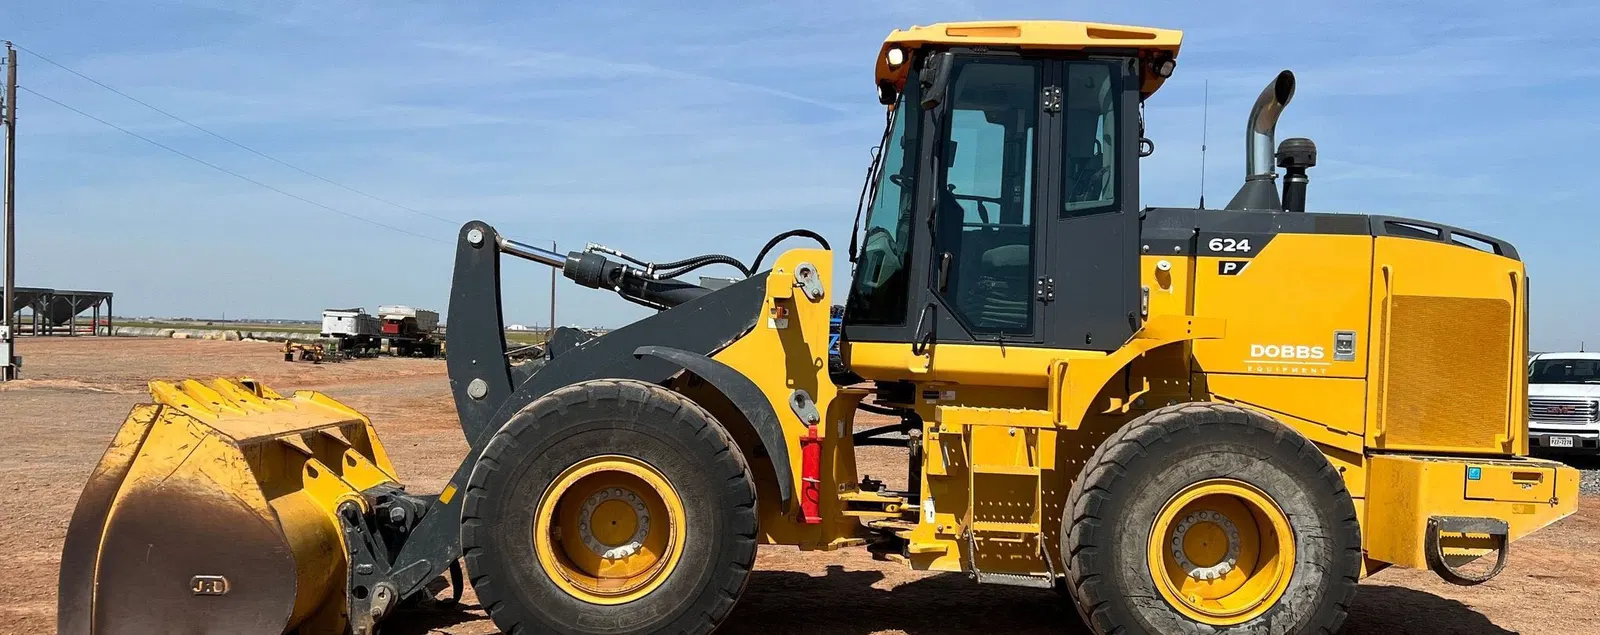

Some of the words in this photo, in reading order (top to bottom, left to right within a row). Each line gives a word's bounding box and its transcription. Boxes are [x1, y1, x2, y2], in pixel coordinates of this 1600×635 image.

[1208, 238, 1251, 252] 624
[1223, 262, 1237, 274] P
[1250, 344, 1325, 359] DOBBS
[1247, 365, 1327, 374] EQUIPMENT
